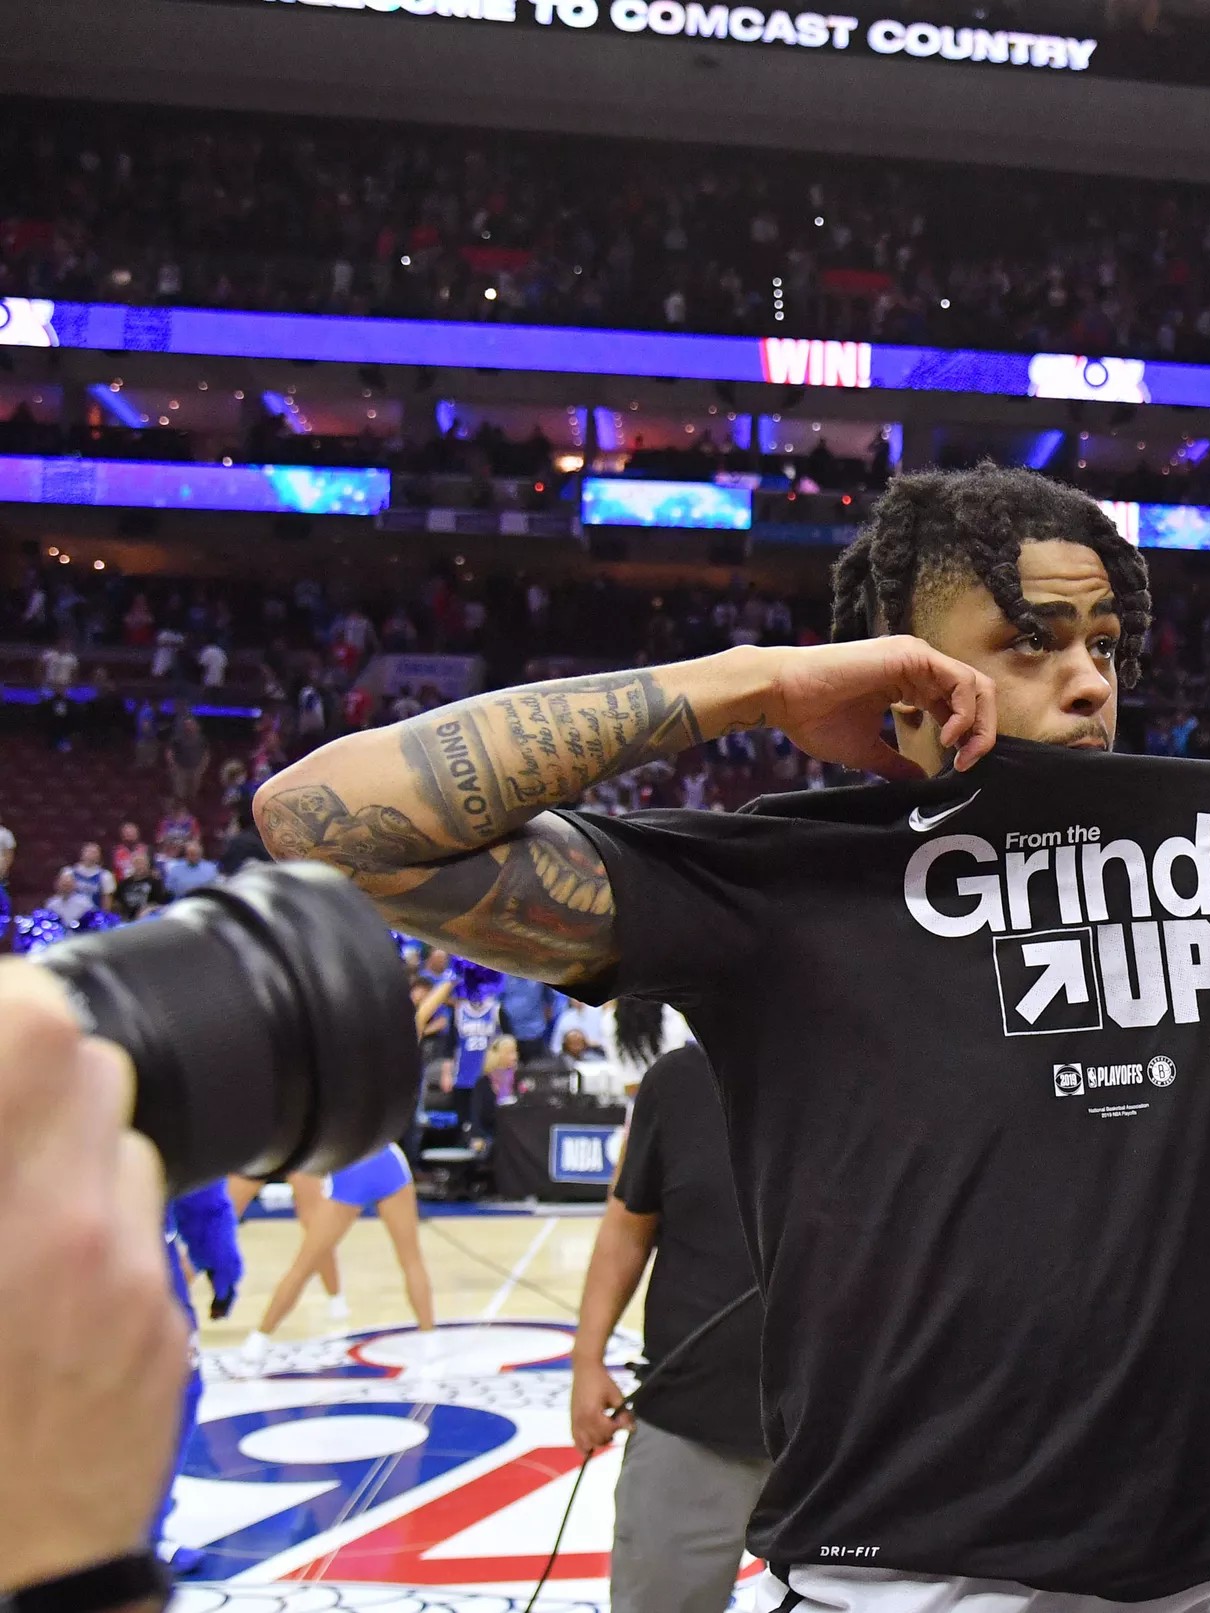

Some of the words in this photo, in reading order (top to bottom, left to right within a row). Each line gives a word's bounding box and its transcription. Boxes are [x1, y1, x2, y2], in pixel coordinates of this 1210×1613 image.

[530, 0, 600, 28] TO
[610, 0, 858, 49] COMCAST
[867, 19, 1098, 71] COUNTRY
[764, 337, 872, 388] WIN!
[1005, 830, 1062, 849] From
[1066, 825, 1101, 844] the
[1059, 1073, 1078, 1087] 2019
[1097, 1064, 1144, 1088] PLAYOFFS
[1158, 1064, 1165, 1079] B
[819, 1545, 881, 1558] DRI-FIT
